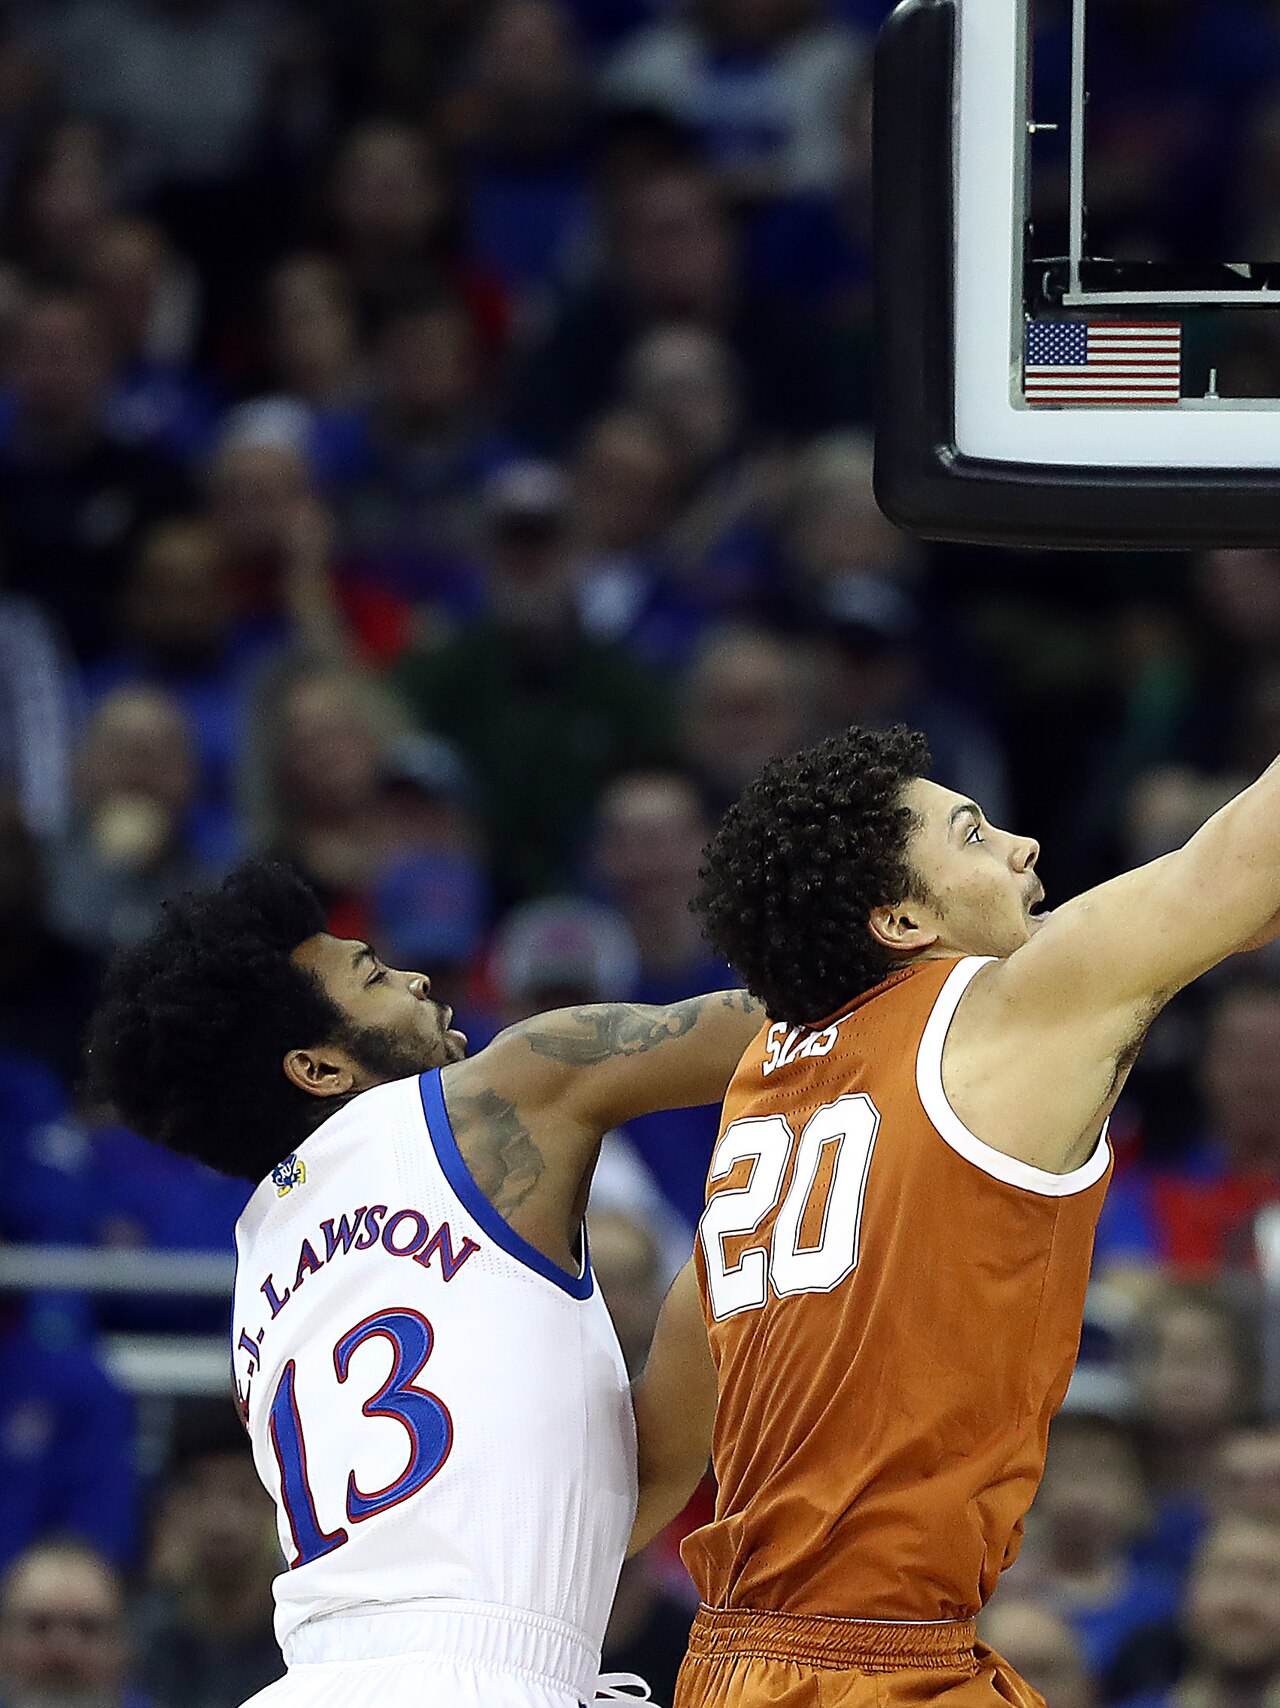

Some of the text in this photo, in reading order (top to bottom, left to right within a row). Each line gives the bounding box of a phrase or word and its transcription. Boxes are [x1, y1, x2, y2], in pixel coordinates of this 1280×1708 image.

[260, 1205, 481, 1320] LAWSON
[699, 1093, 882, 1323] 20
[270, 1307, 454, 1569] 13
